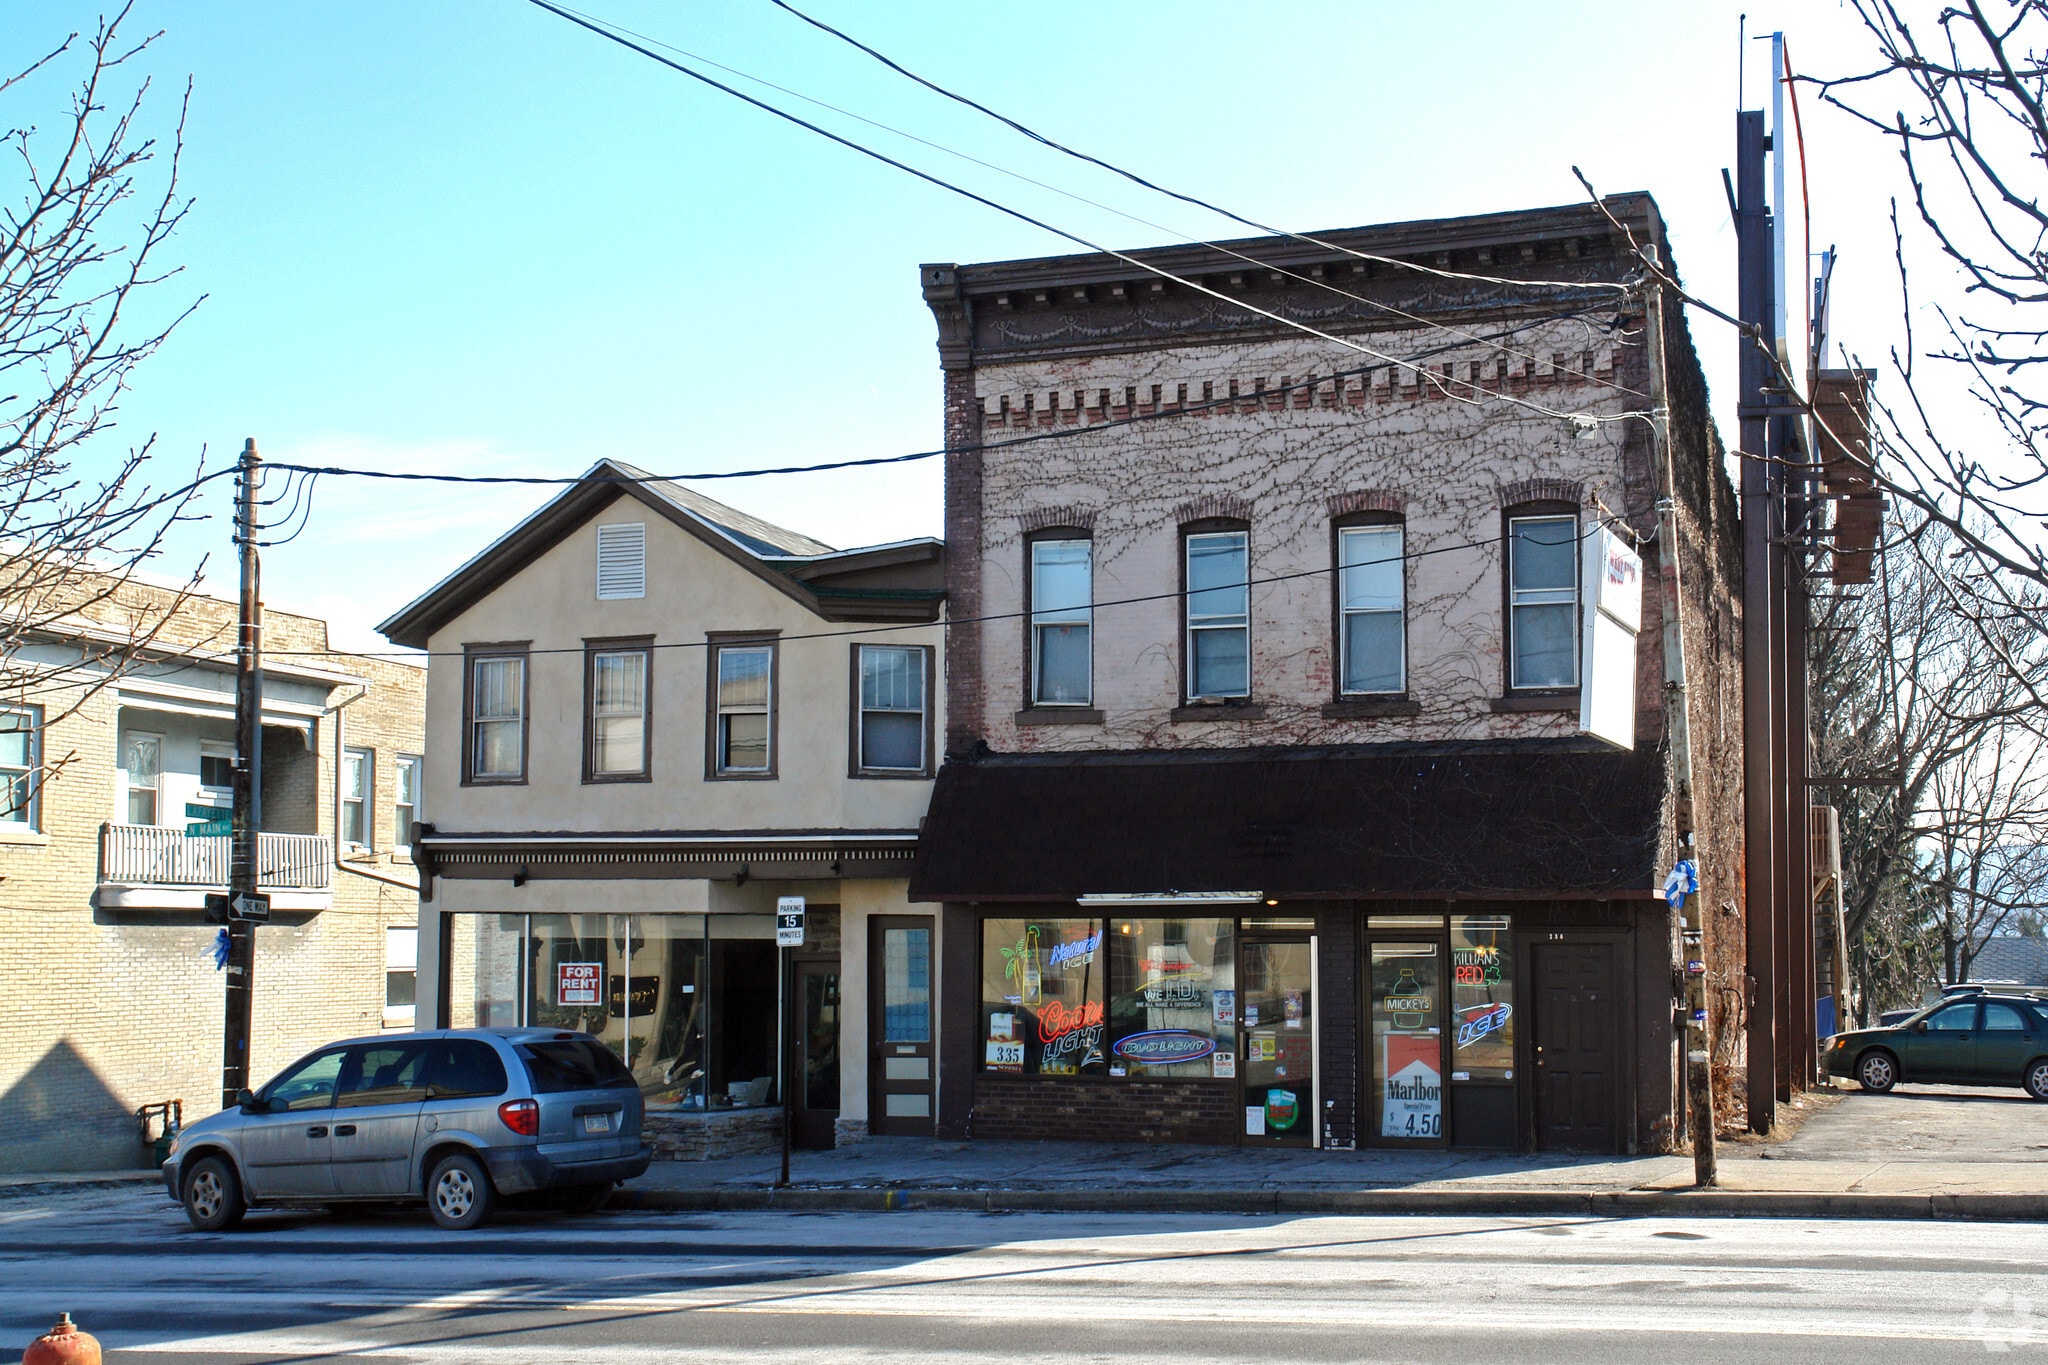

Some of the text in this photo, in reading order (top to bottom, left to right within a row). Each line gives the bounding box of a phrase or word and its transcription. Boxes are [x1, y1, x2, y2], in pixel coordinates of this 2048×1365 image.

[189, 824, 195, 836] N
[200, 823, 221, 835] MAIN
[243, 900, 267, 913] ONE WAY
[784, 915, 797, 928] 15
[779, 930, 802, 939] MINUTES
[1050, 930, 1103, 965] Natural
[1063, 952, 1094, 970] ICE
[1454, 952, 1499, 966] KILLIAN'S
[566, 967, 593, 977] FOR
[1456, 965, 1484, 985] RED
[562, 978, 598, 989] RENT
[1144, 990, 1163, 1001] WE
[1458, 1008, 1508, 1043] ICE
[1042, 1024, 1104, 1063] LIGHT
[1122, 1041, 1205, 1053] BUD LIGHT
[997, 1047, 1019, 1063] 335
[1390, 1112, 1394, 1121] $
[1405, 1113, 1441, 1135] 4.50
